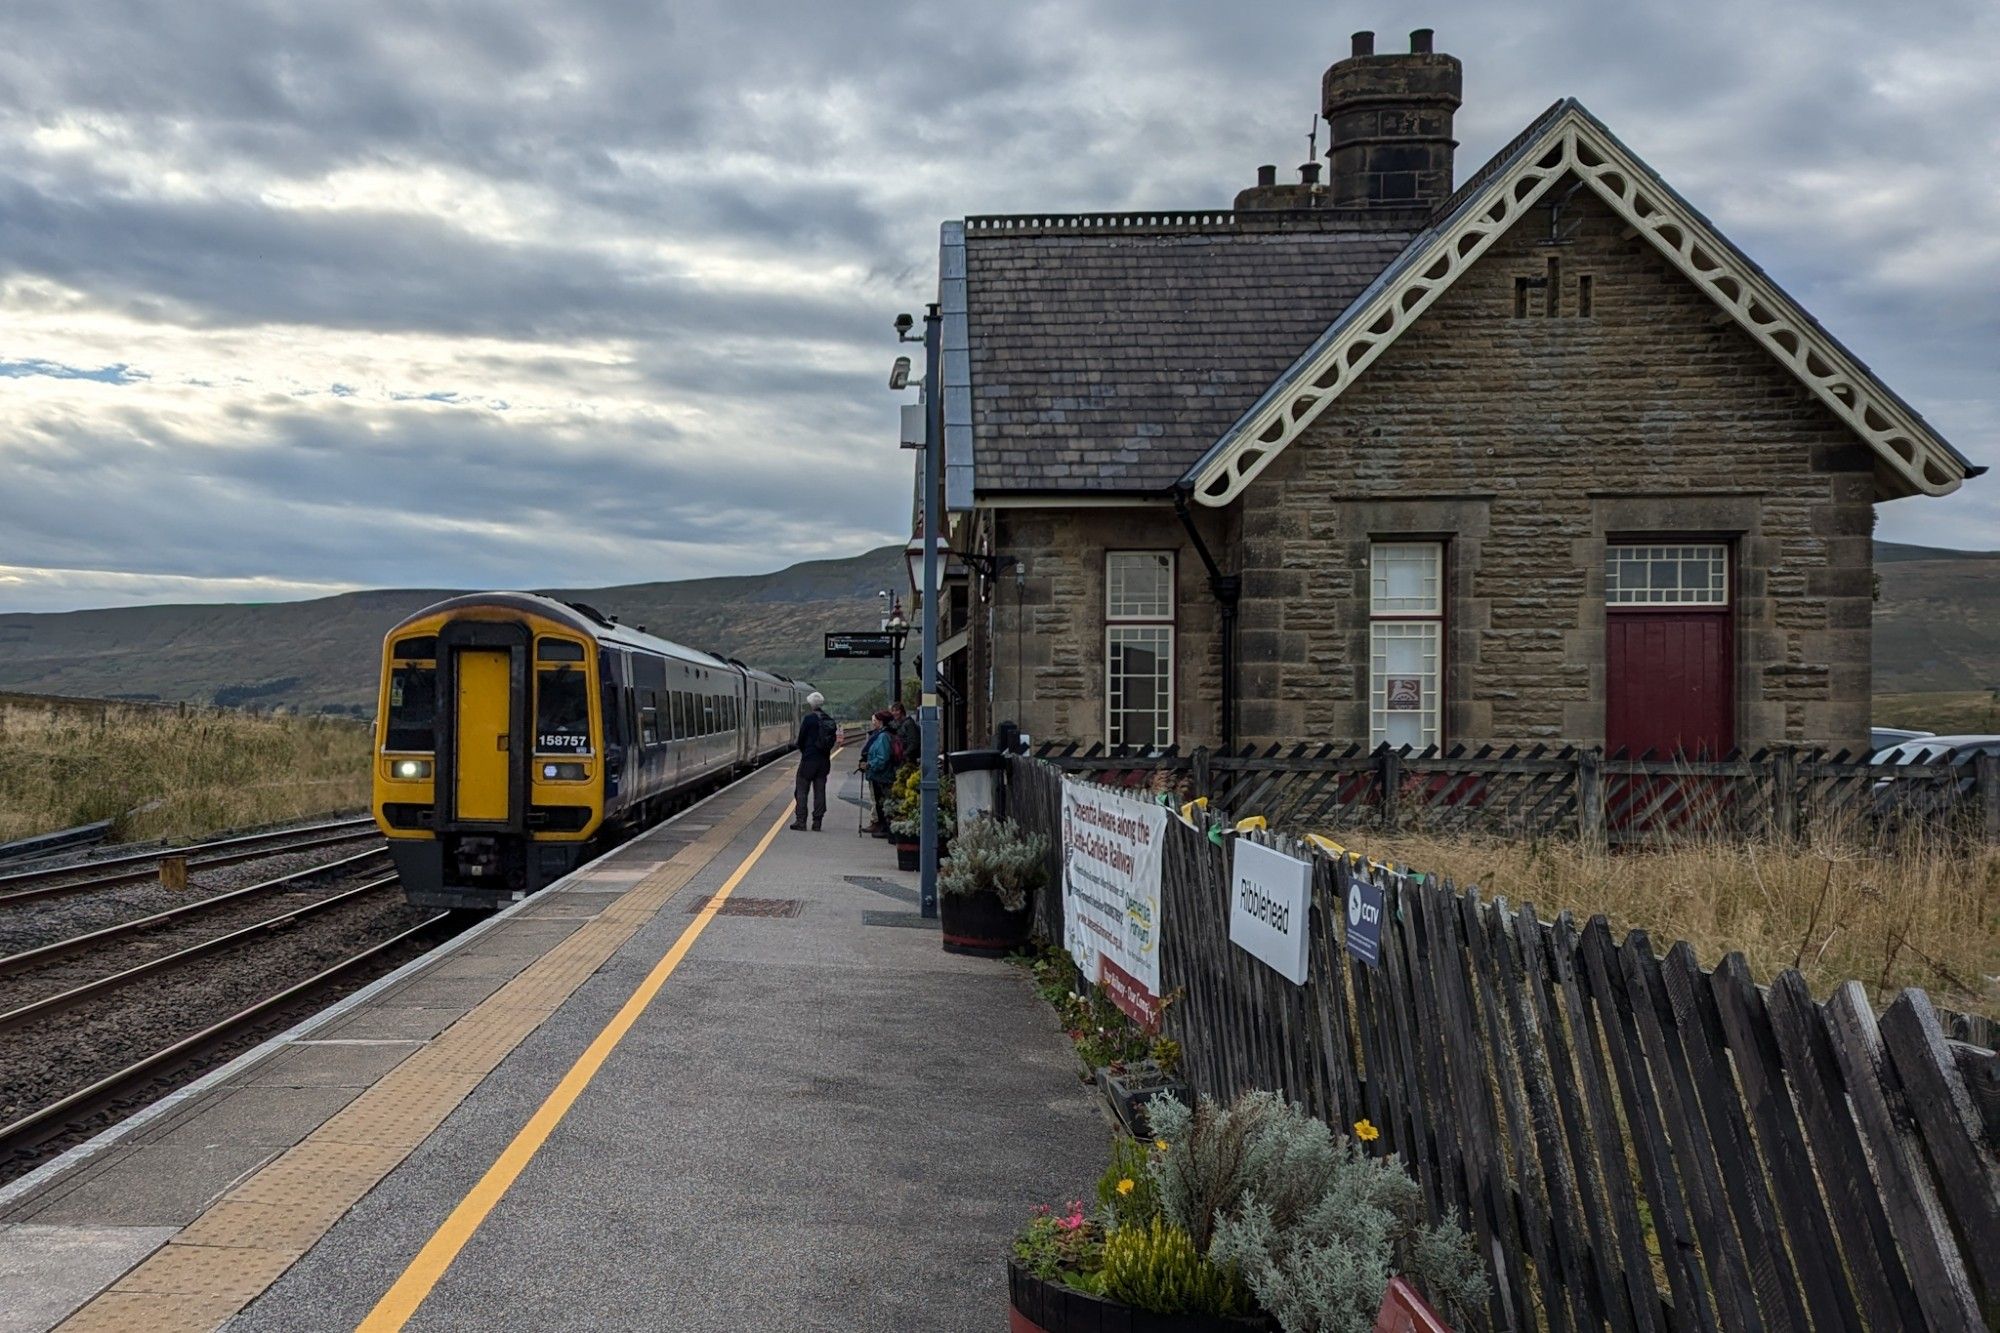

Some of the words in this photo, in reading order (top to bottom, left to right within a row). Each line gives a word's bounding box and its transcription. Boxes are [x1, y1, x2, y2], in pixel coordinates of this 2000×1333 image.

[539, 735, 586, 746] 158757
[1098, 802, 1117, 833] Aware
[1117, 808, 1136, 846] along
[1138, 814, 1150, 846] the
[1109, 840, 1135, 882] Railway
[1240, 878, 1290, 935] Ribblehead
[1362, 903, 1379, 925] CCTV
